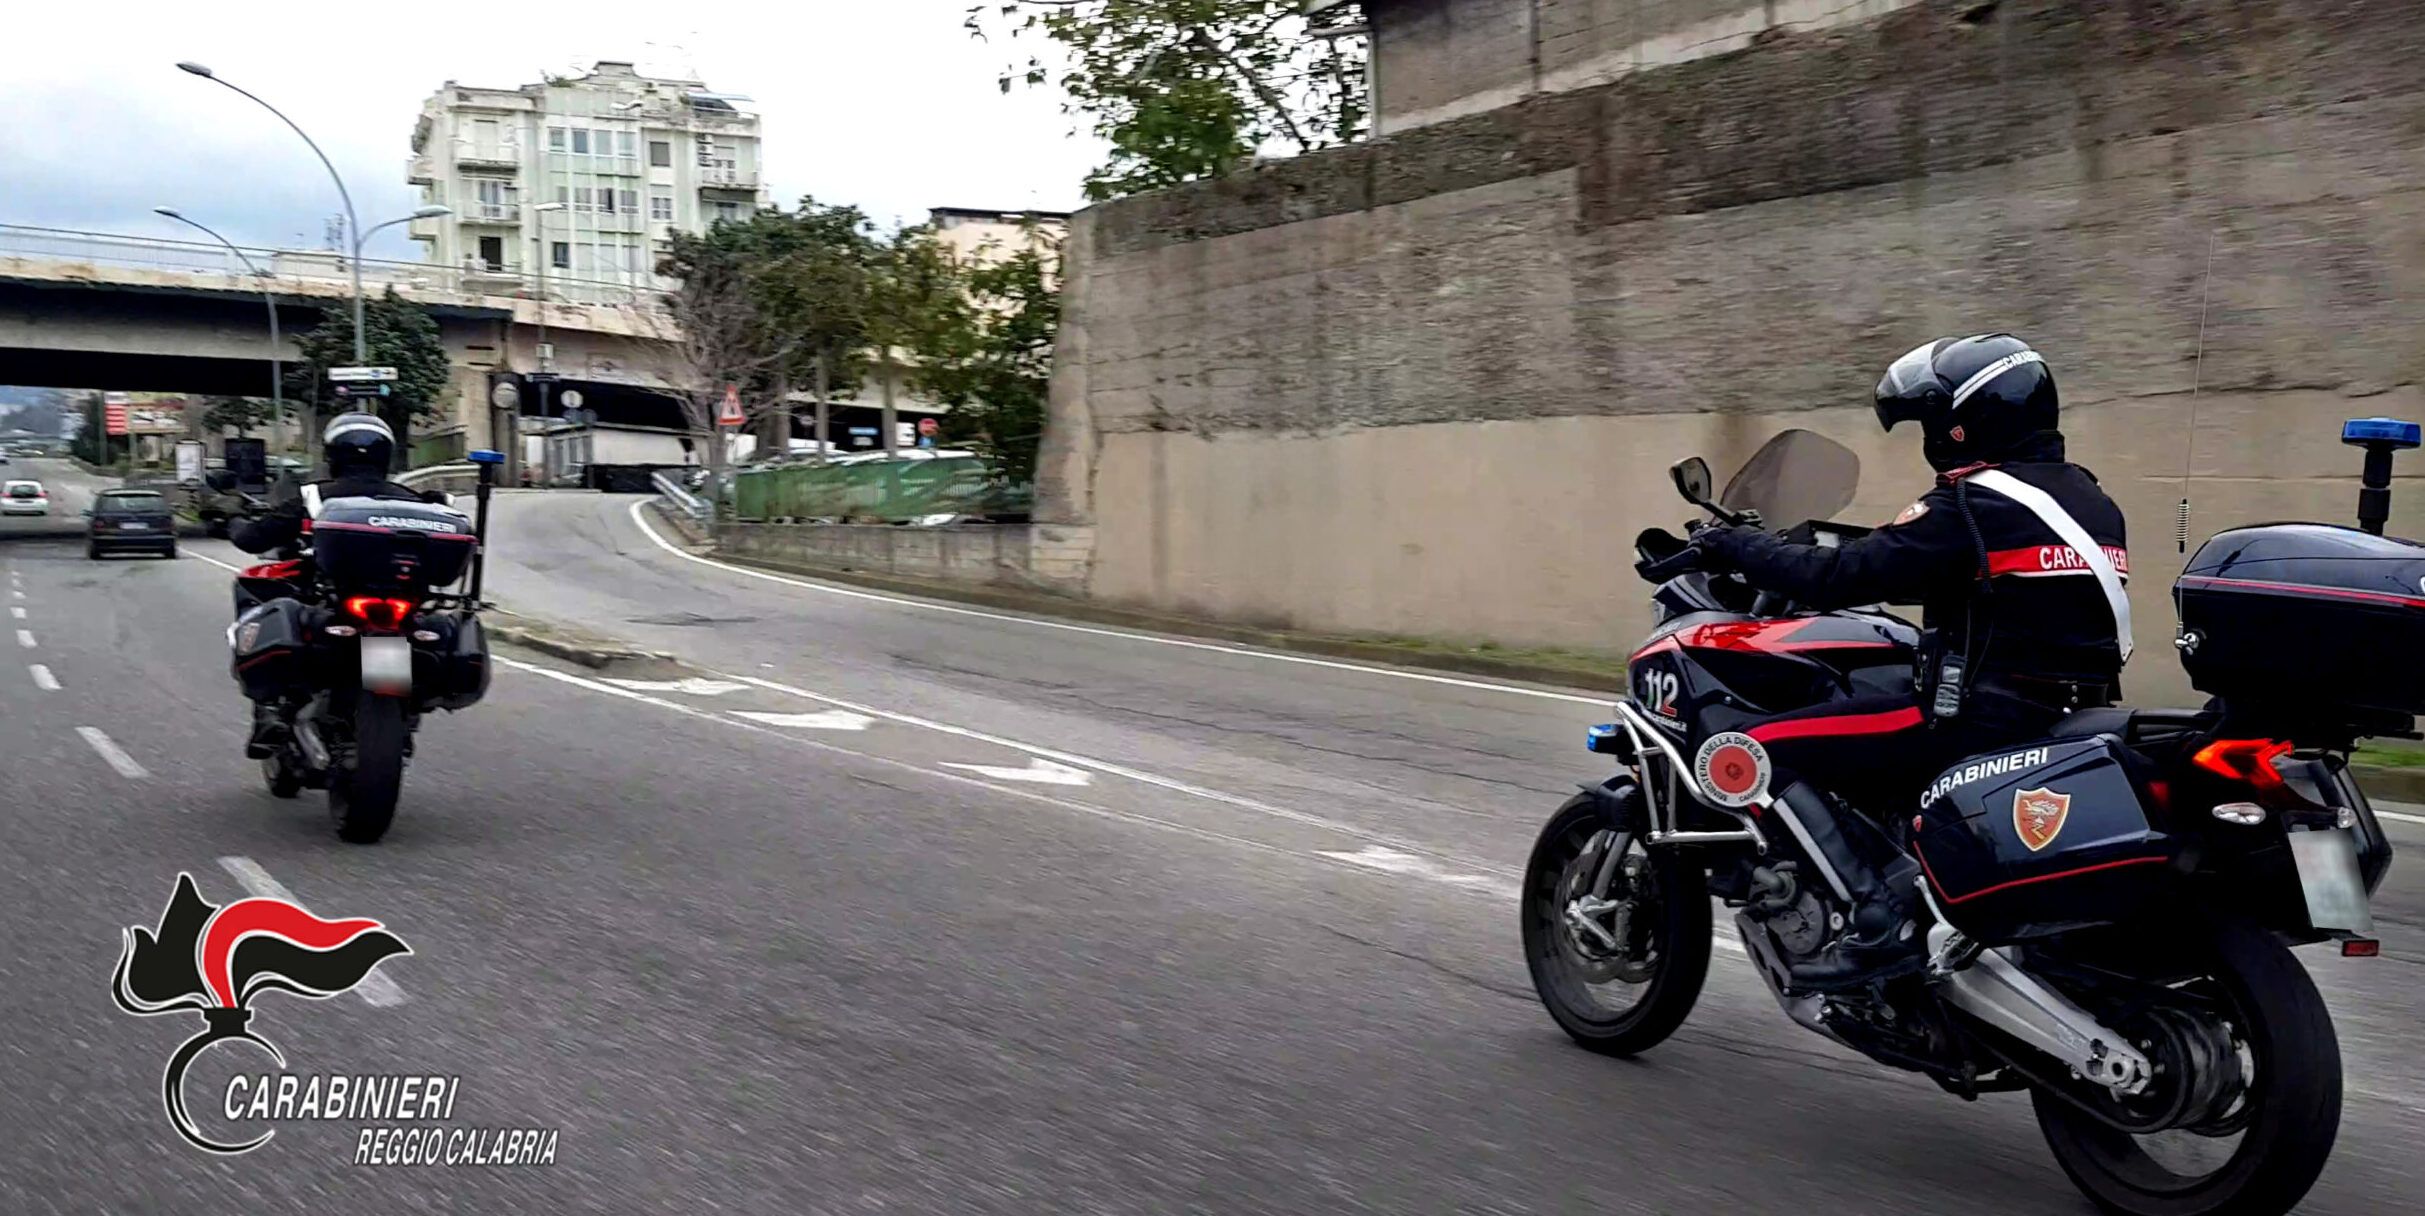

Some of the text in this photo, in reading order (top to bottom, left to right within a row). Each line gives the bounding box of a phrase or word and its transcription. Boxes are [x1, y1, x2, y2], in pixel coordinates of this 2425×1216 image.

[367, 516, 457, 533] CARABINIERI
[1645, 668, 1678, 717] 112
[1704, 736, 1732, 756] DELLA
[1734, 736, 1764, 762] DIFESA
[1920, 747, 2049, 809] CARABINIERI
